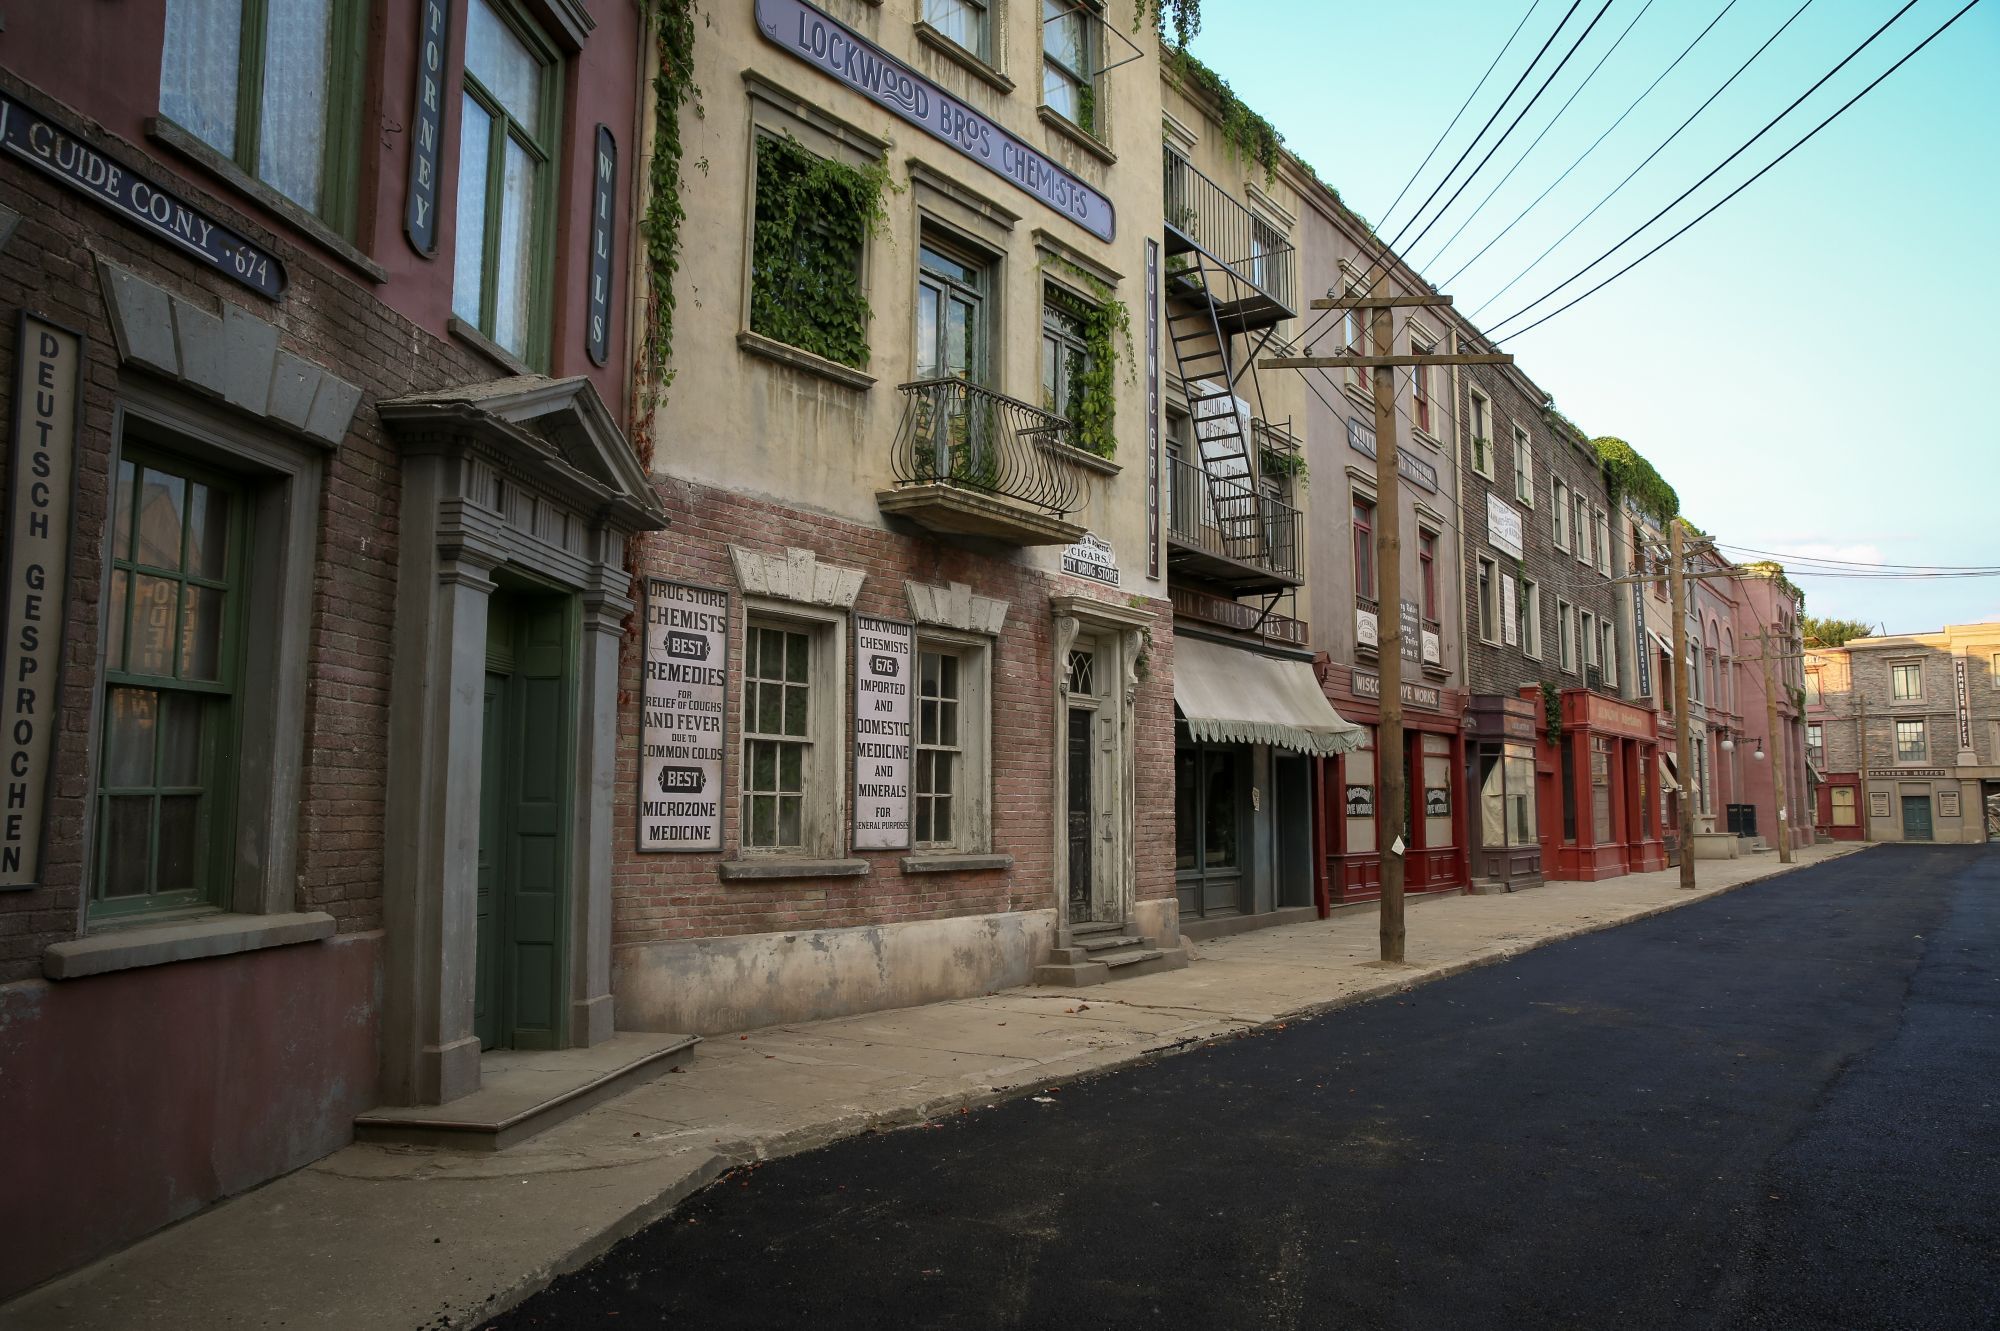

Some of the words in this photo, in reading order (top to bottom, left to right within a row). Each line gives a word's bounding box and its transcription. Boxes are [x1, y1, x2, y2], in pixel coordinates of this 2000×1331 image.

[798, 11, 930, 120] LOCKWOOD
[29, 122, 122, 198] GUIDE
[593, 152, 612, 343] WILLS
[29, 331, 60, 539] DEUTSCH
[1071, 547, 1107, 564] CIGARS
[1078, 561, 1095, 576] DRUG
[1097, 567, 1118, 583] STORE
[649, 582, 683, 601] DRUG
[686, 589, 725, 608] STORE
[648, 604, 726, 633] CHEMISTS
[1213, 600, 1240, 625] GROVE
[859, 617, 908, 637] LOCKWOOD
[672, 638, 703, 655] BEST
[860, 636, 909, 654] CHESMISTS
[647, 661, 725, 687] REMEDIES
[875, 658, 893, 673] 676
[677, 690, 692, 699] FOR
[860, 679, 905, 695] IMPORTED
[646, 696, 676, 709] RELIEF
[678, 701, 687, 710] OF
[688, 700, 722, 713] COUGHS
[874, 699, 893, 712] AND
[2, 564, 45, 873] GESPROCHEN
[645, 712, 674, 729] AND
[677, 714, 720, 732] FEVER
[857, 719, 909, 737] DOMESTIC
[672, 733, 685, 742] DUE
[687, 734, 697, 743] TO
[643, 744, 689, 759] COMMON
[691, 747, 722, 760] COLDS
[857, 743, 909, 760] MEDICINE
[667, 771, 699, 787] BEST
[874, 765, 893, 777] AND
[858, 784, 907, 798] MINERALS
[643, 801, 716, 817] MICROZONE
[875, 807, 891, 818] FOR
[649, 825, 711, 841] MEDICINE
[882, 821, 909, 830] PURPOSES
